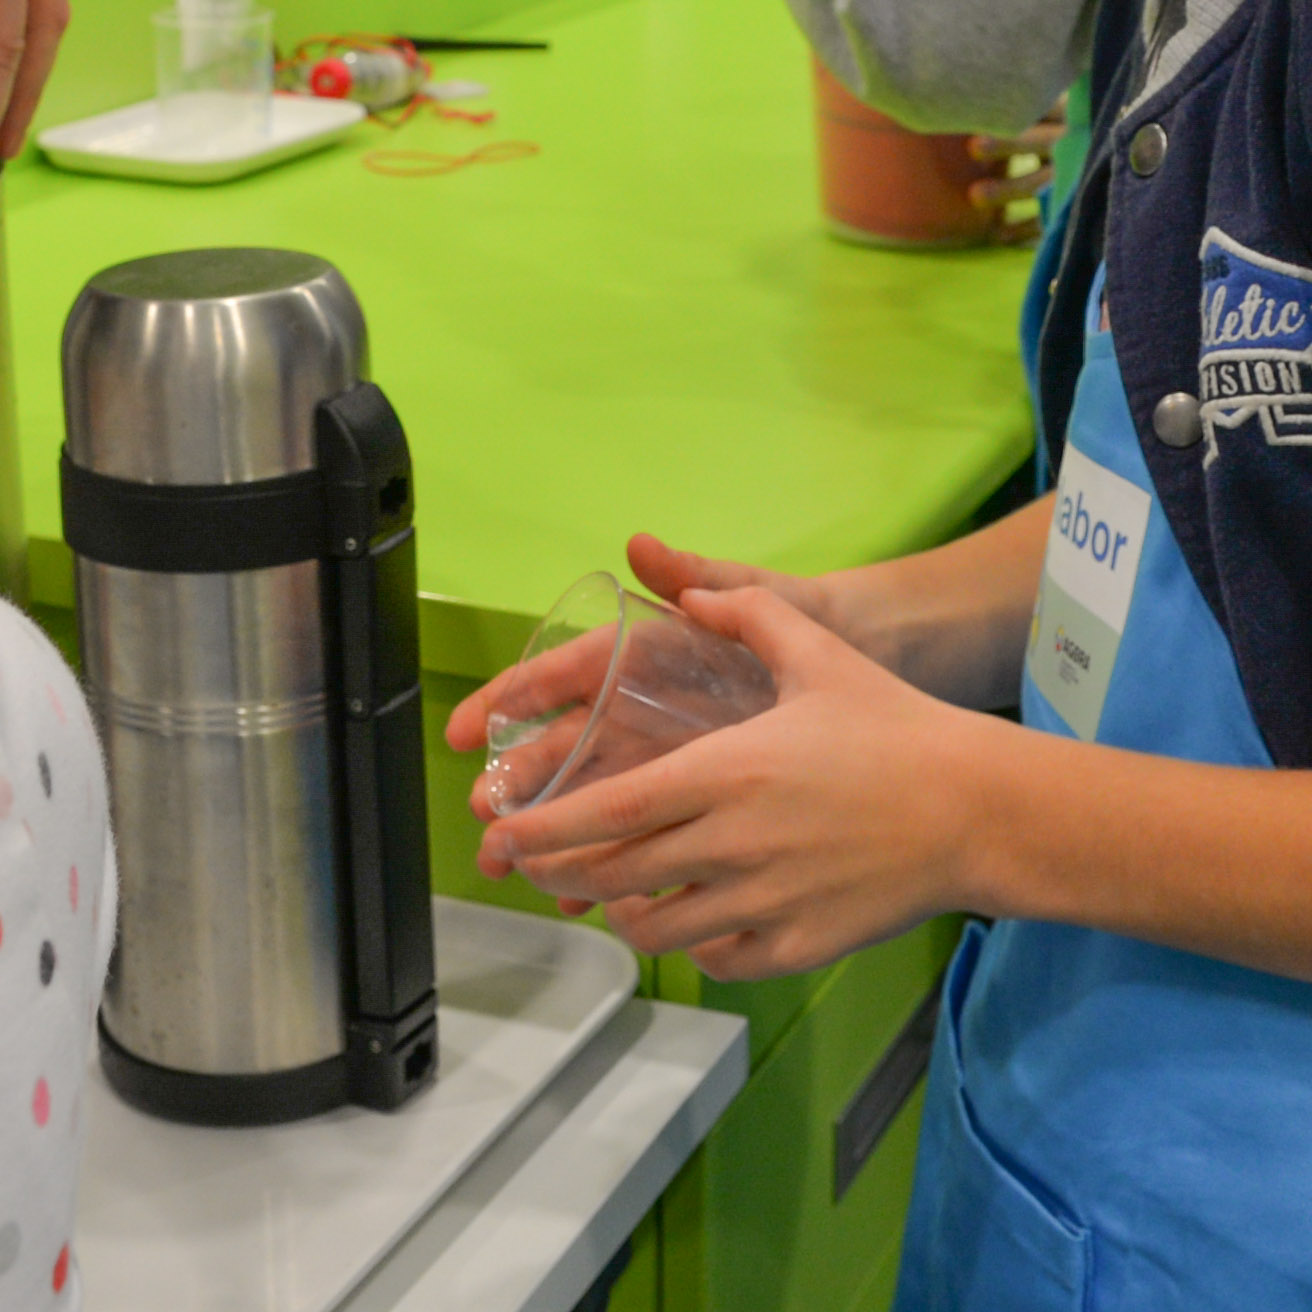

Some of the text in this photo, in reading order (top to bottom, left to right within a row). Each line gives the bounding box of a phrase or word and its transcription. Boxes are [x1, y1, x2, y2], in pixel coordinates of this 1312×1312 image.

[1201, 284, 1306, 346] letic
[1202, 359, 1302, 400] ISION
[1057, 489, 1128, 571] abor
